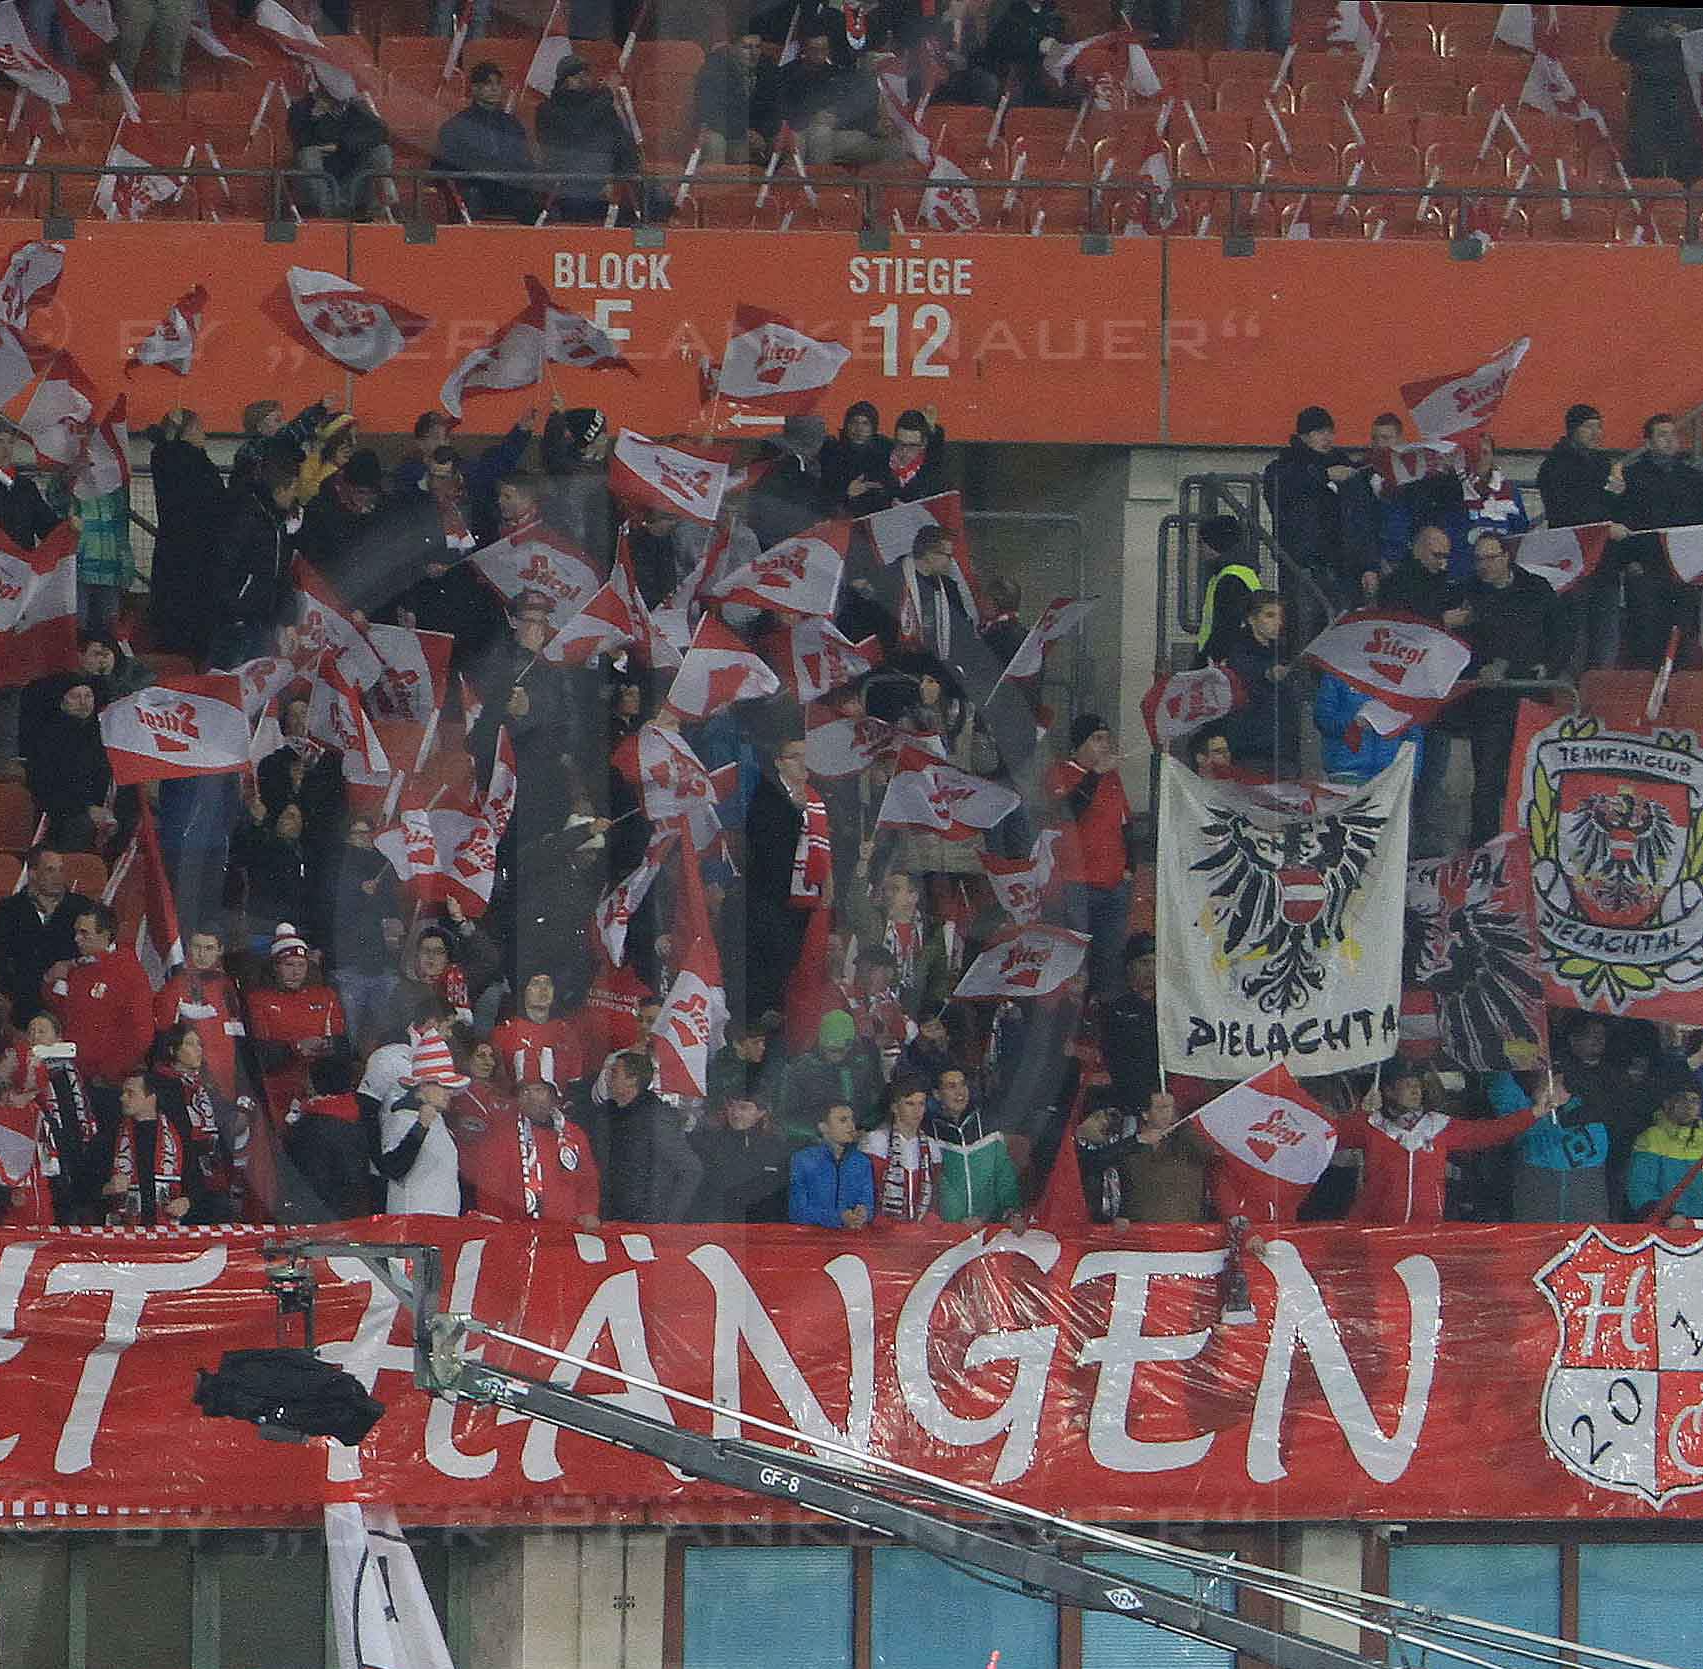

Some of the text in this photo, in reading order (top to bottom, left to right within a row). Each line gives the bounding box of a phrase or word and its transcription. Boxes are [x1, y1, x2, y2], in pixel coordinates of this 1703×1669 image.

[555, 252, 672, 290] BLOCK
[848, 256, 973, 297] STIEGE
[868, 303, 952, 379] 12
[319, 1230, 1439, 1487] HÄNGEN
[759, 1468, 800, 1494] GF-8
